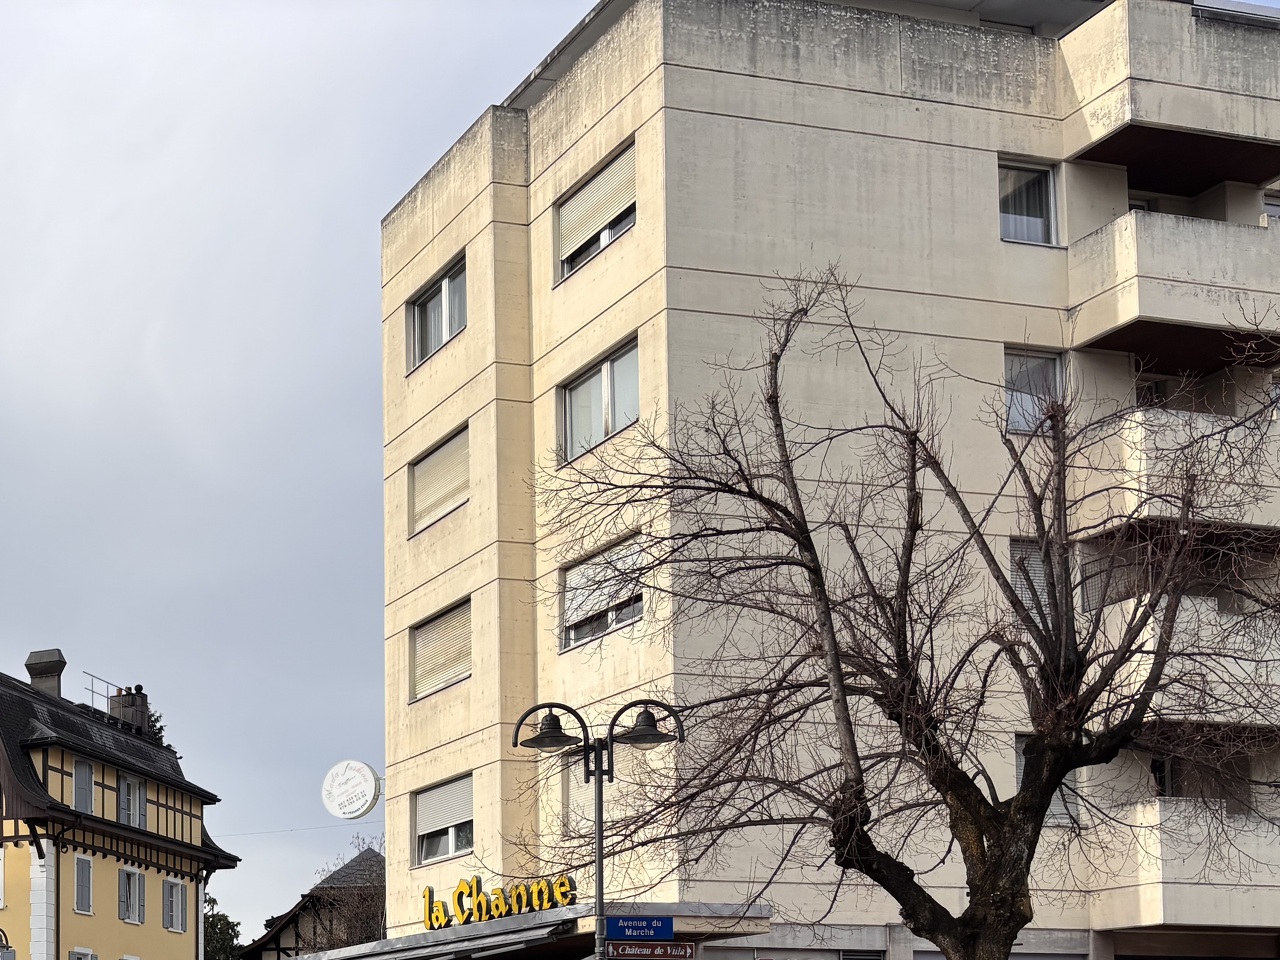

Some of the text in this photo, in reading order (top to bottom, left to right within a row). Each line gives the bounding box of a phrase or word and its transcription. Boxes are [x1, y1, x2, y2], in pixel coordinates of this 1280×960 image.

[422, 874, 577, 930] la Channe
[618, 919, 662, 927] Avenue du
[625, 928, 655, 936] Marché
[618, 945, 686, 955] Château de Villa
